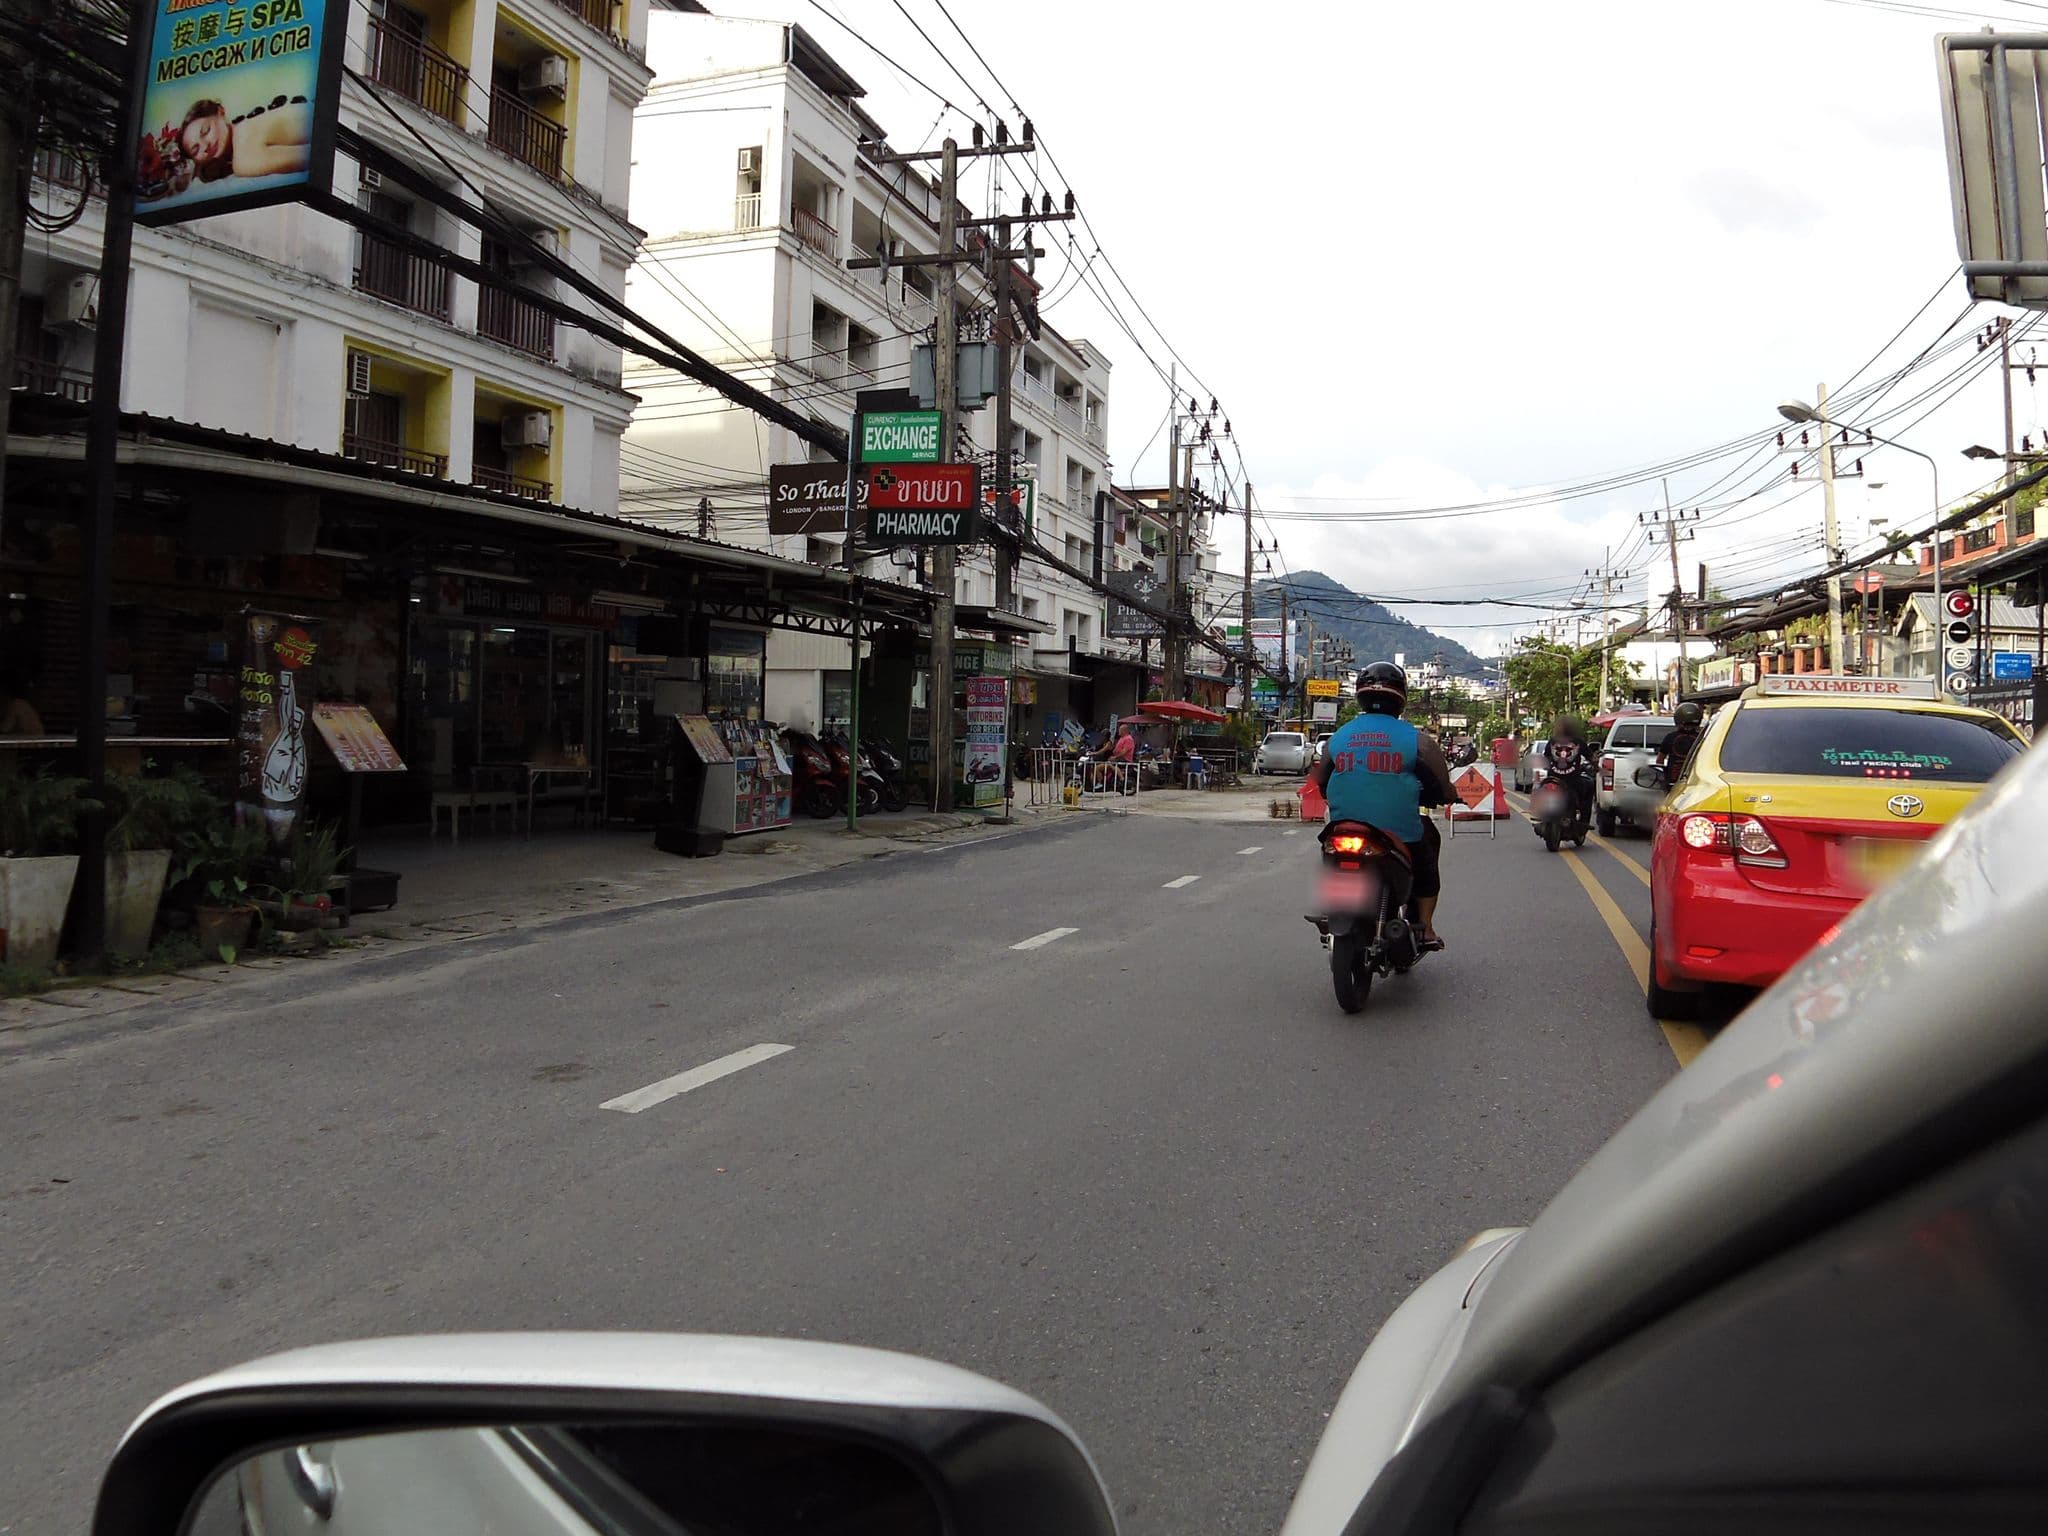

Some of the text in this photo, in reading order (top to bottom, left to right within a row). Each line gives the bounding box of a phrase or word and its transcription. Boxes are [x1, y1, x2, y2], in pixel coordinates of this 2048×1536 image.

[251, 0, 303, 30] SPA
[865, 426, 937, 450] EXCHANGE
[776, 484, 798, 501] So
[804, 480, 848, 499] Thai
[898, 480, 962, 502] ขายยา
[877, 513, 960, 536] PHARMACY
[1784, 679, 1900, 693] TAXI-METER
[968, 711, 1004, 723] MOTORBIKE
